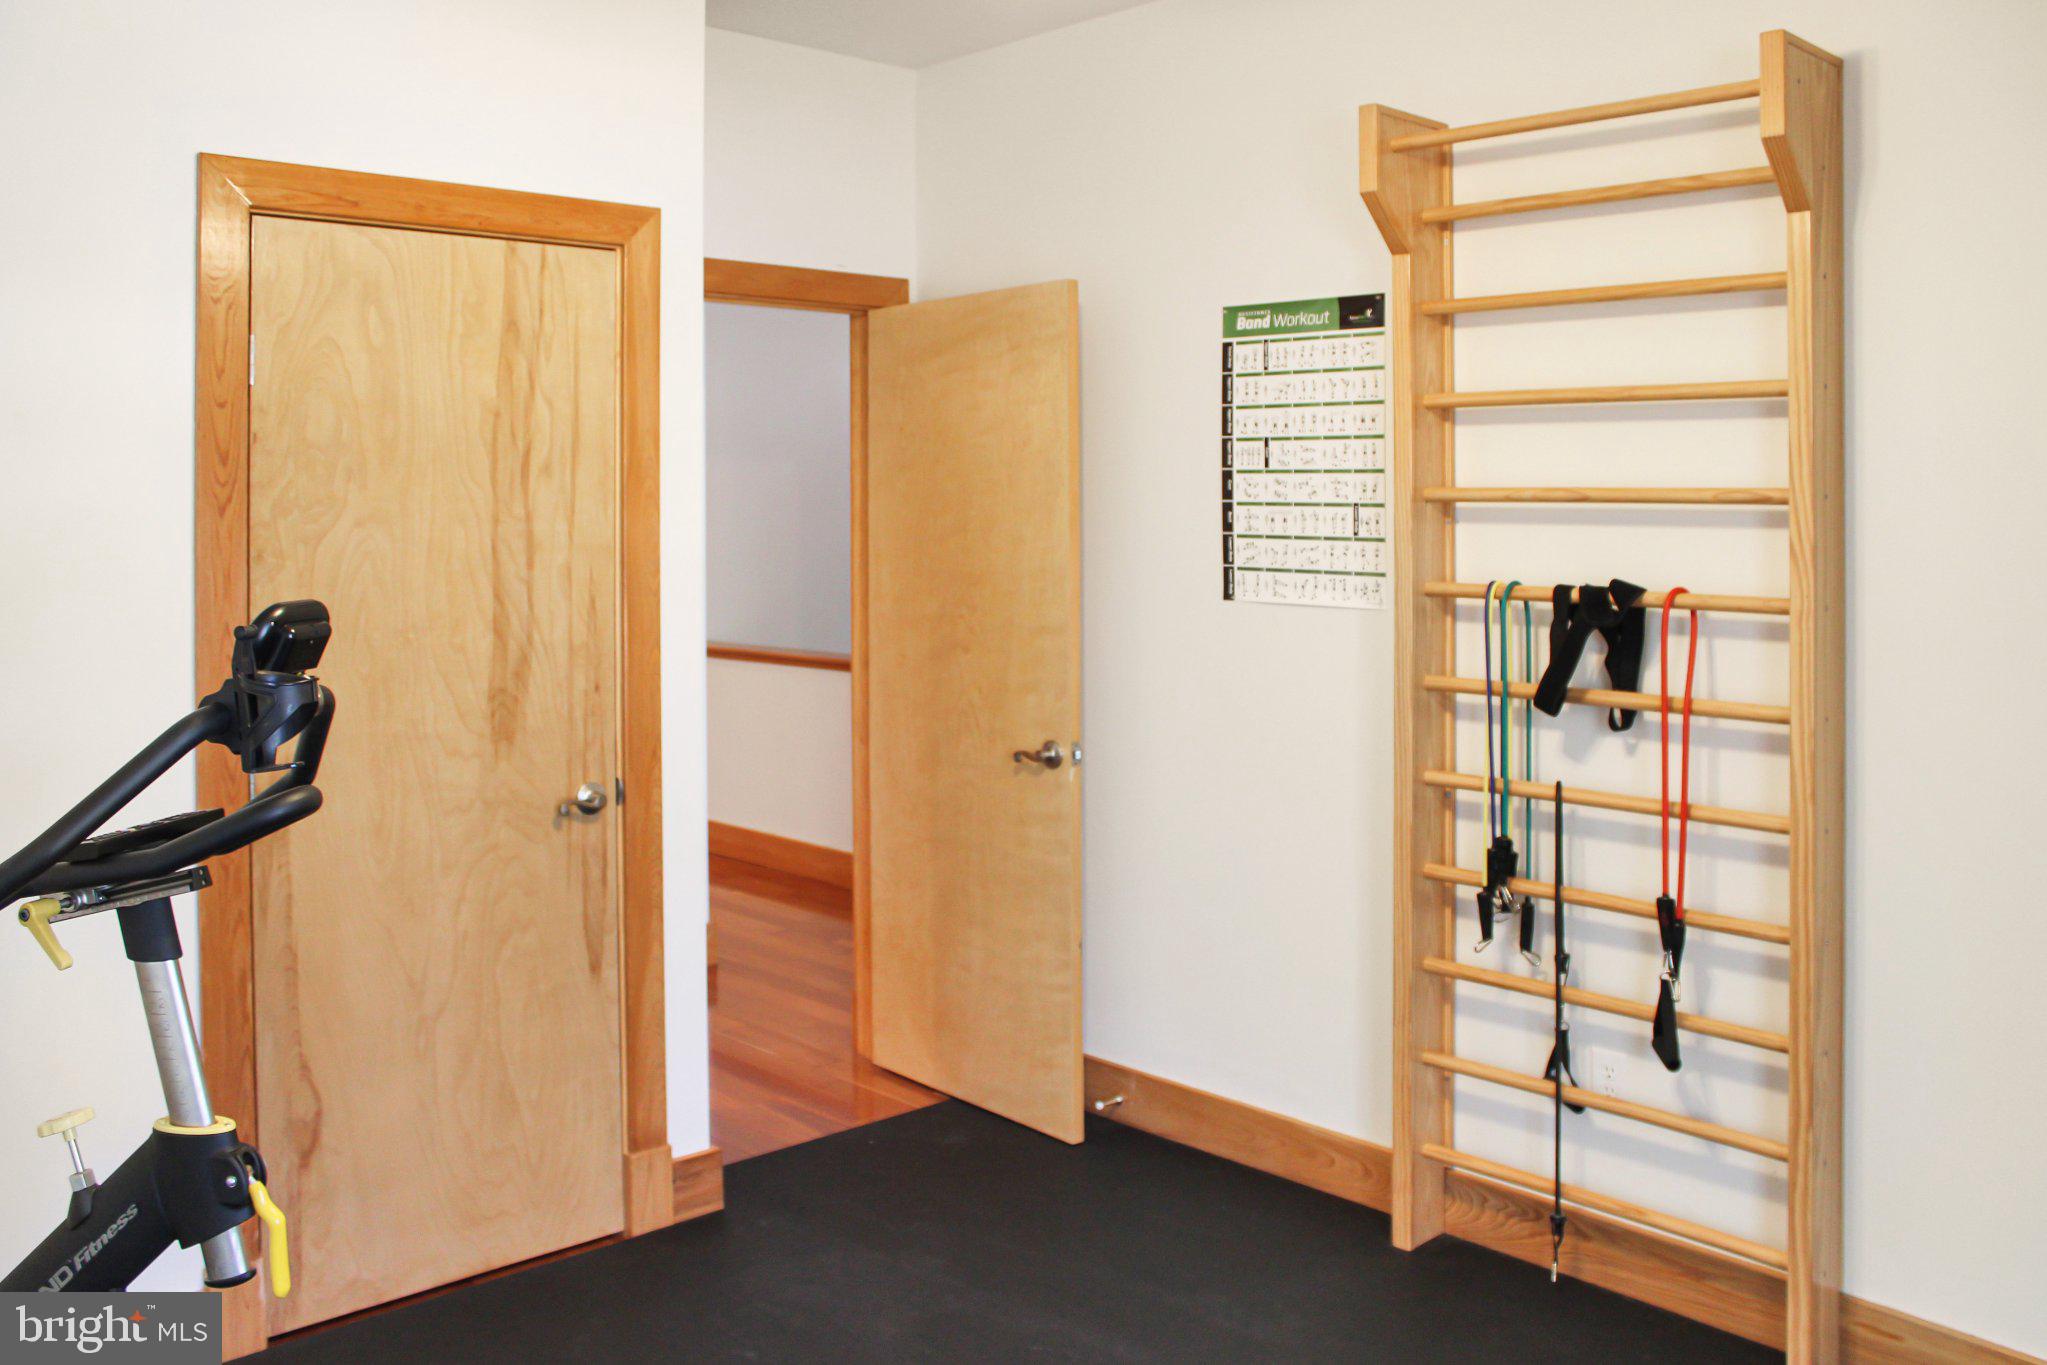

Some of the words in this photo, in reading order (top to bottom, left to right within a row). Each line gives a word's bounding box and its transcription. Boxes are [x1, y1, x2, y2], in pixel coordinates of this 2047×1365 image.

[1236, 310, 1271, 330] Band
[1273, 310, 1330, 327] Workout
[73, 1203, 138, 1272] Fitness
